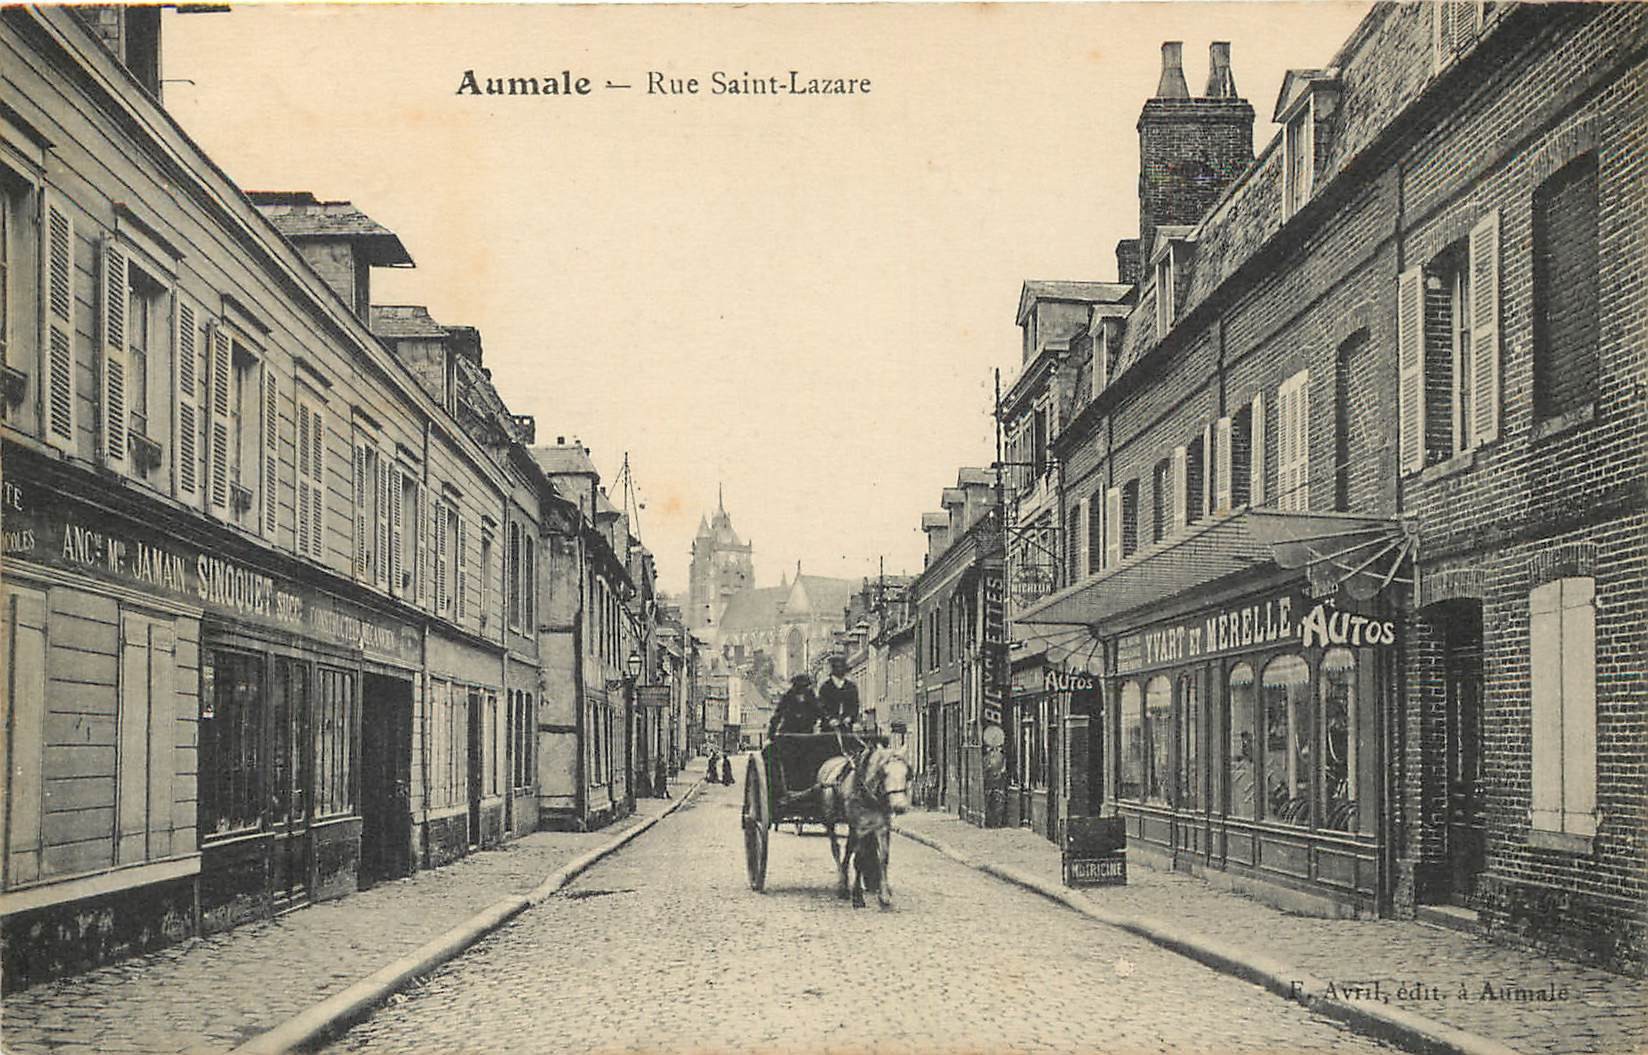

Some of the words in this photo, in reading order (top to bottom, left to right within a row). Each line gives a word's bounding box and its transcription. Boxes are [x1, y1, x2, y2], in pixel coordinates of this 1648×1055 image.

[197, 552, 273, 617] SINOQUET
[1145, 626, 1185, 664] YVART
[1189, 627, 1201, 657] ET
[1302, 605, 1395, 648] AUTOS
[1045, 669, 1093, 692] AUTOS
